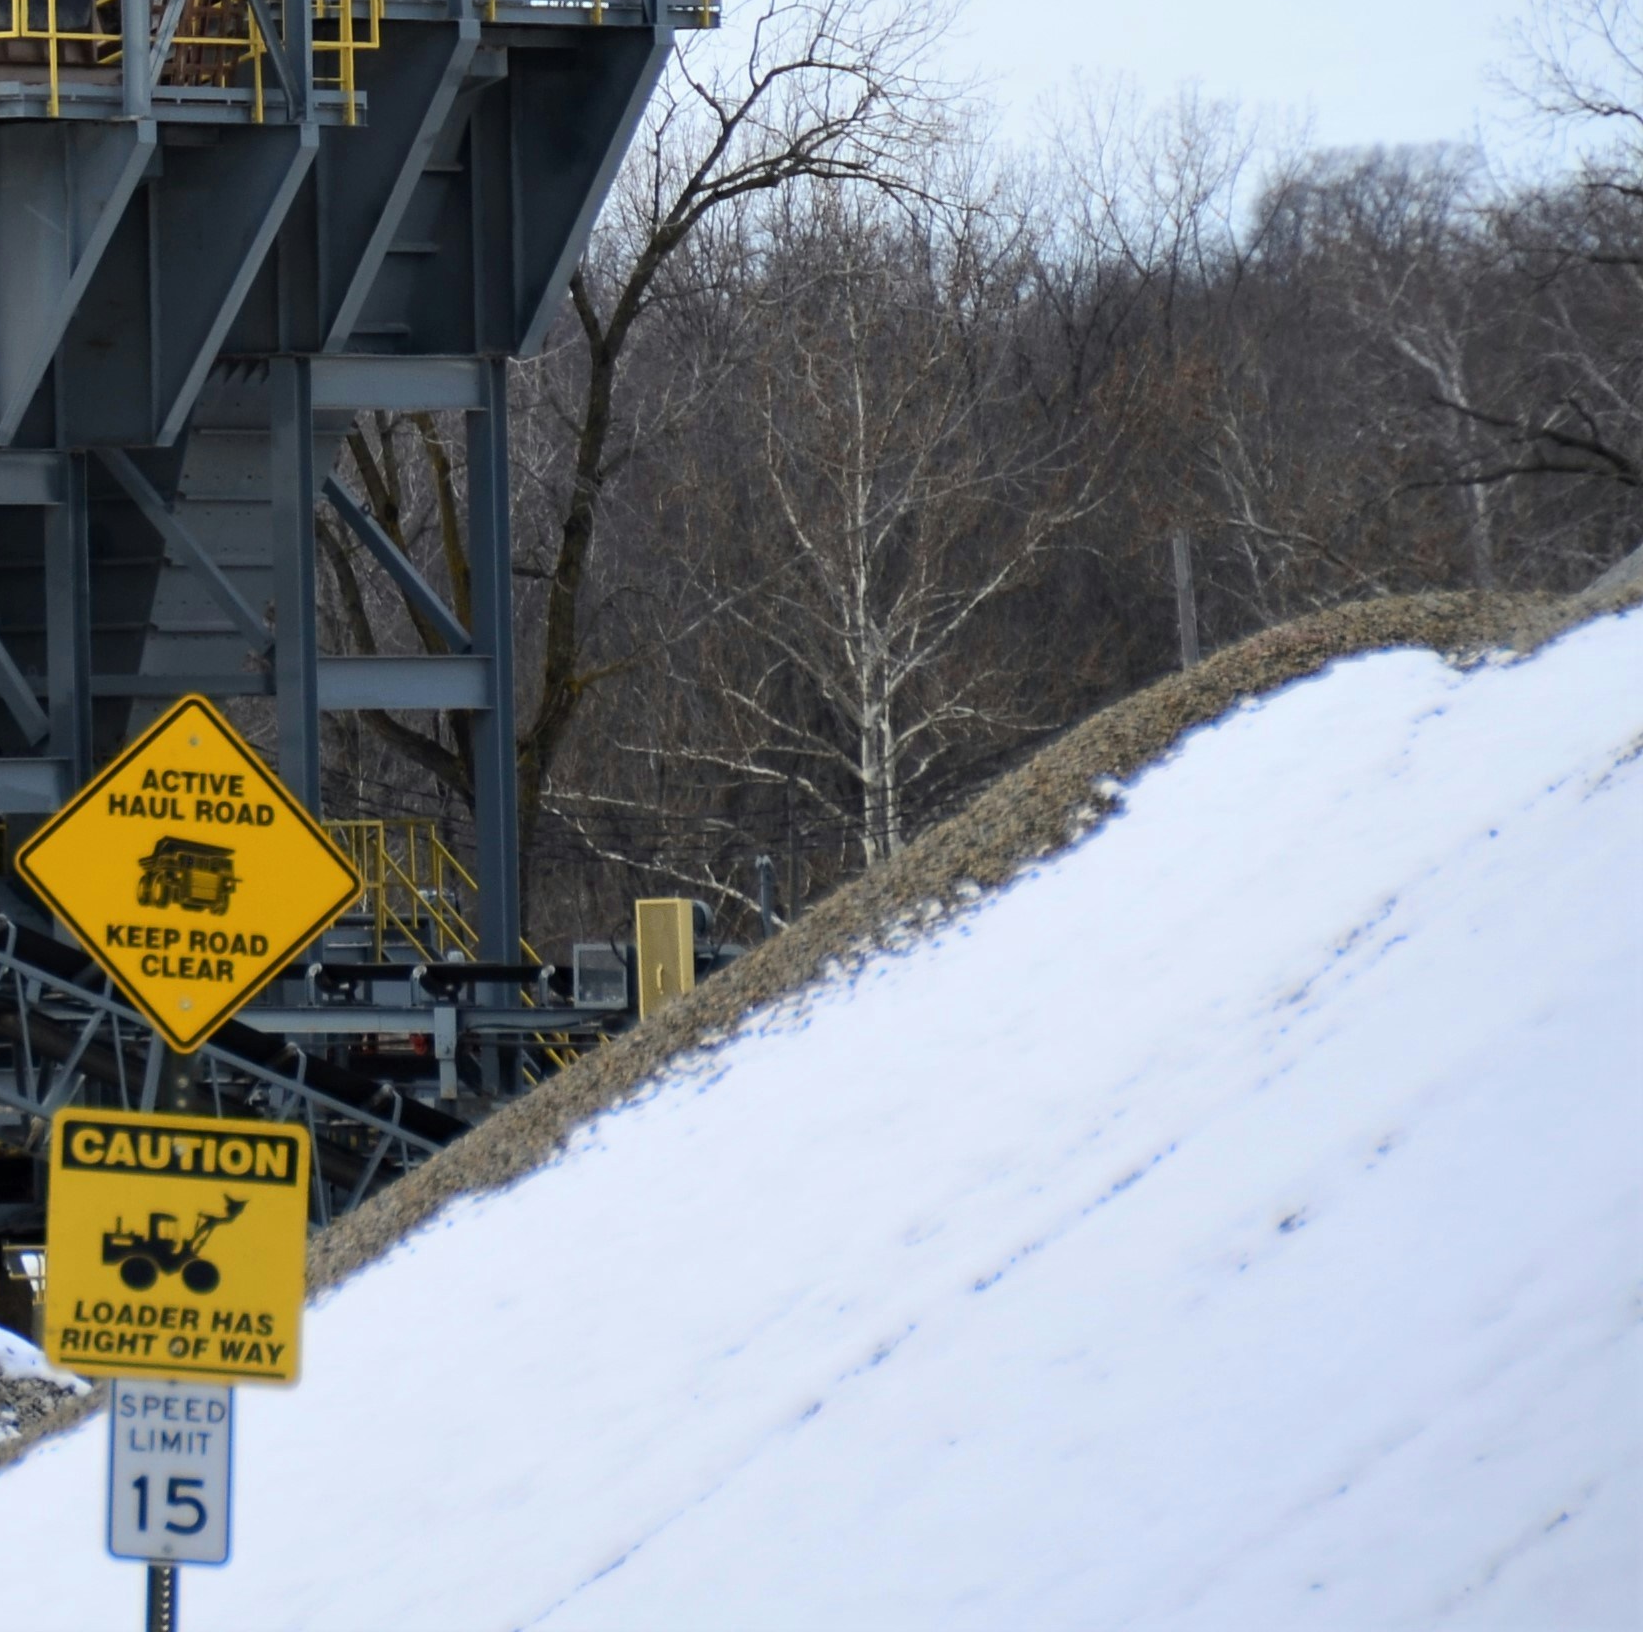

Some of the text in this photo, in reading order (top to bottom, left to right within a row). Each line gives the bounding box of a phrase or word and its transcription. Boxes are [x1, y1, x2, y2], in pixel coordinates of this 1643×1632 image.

[141, 769, 245, 798] ACTIVE
[108, 794, 275, 827] HAUL ROAD
[106, 924, 269, 957] KEEP ROAD
[141, 954, 235, 982] CLEAR
[70, 1128, 288, 1178] CAUTION
[75, 1300, 274, 1337] LOADER HAS
[60, 1328, 285, 1366] RIGHT OF WAY
[120, 1394, 226, 1423] SPEED
[129, 1427, 212, 1455] LIMIT
[132, 1474, 208, 1536] 15
